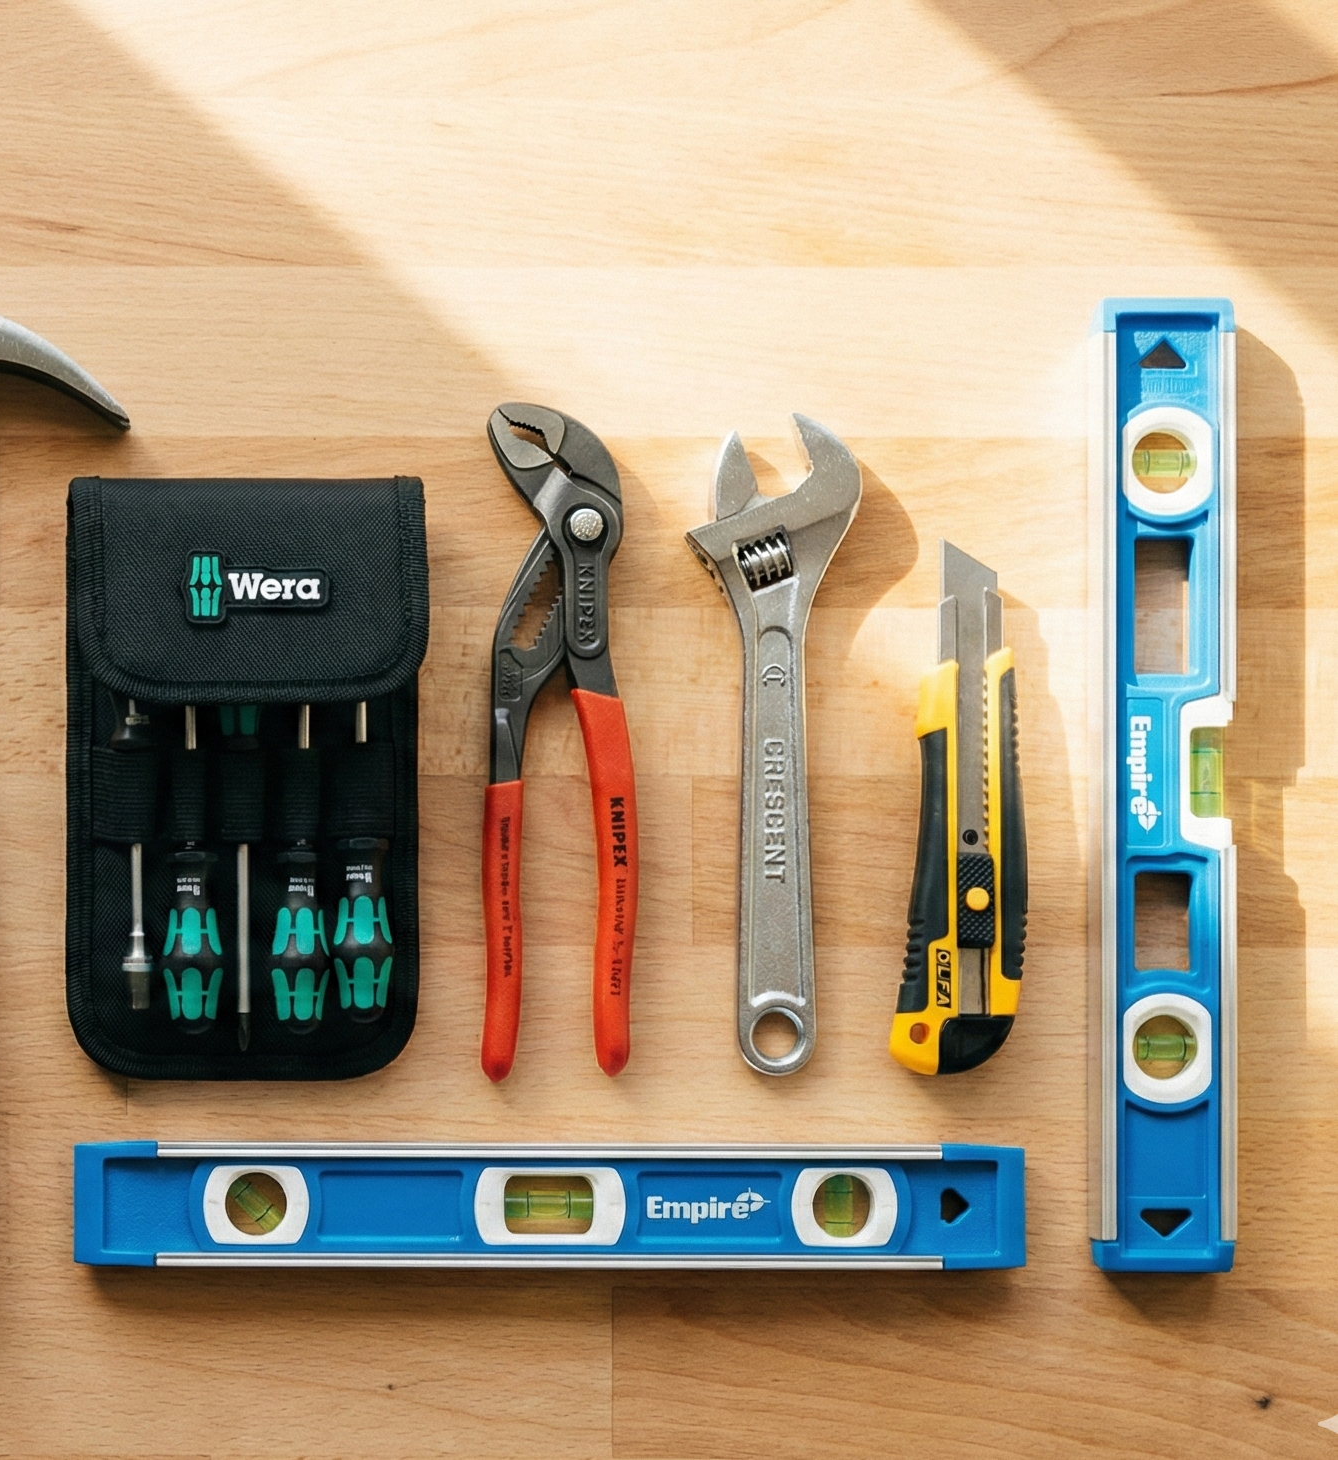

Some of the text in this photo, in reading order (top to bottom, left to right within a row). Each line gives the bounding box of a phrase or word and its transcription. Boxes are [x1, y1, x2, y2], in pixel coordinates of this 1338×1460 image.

[228, 573, 321, 600] Wera
[579, 563, 596, 643] KNIPEX
[1126, 715, 1153, 816] Empire
[610, 797, 628, 868] KNIPEX
[764, 738, 786, 884] CRESCENT
[937, 951, 951, 1005] OLFA
[646, 1196, 750, 1224] Empire
